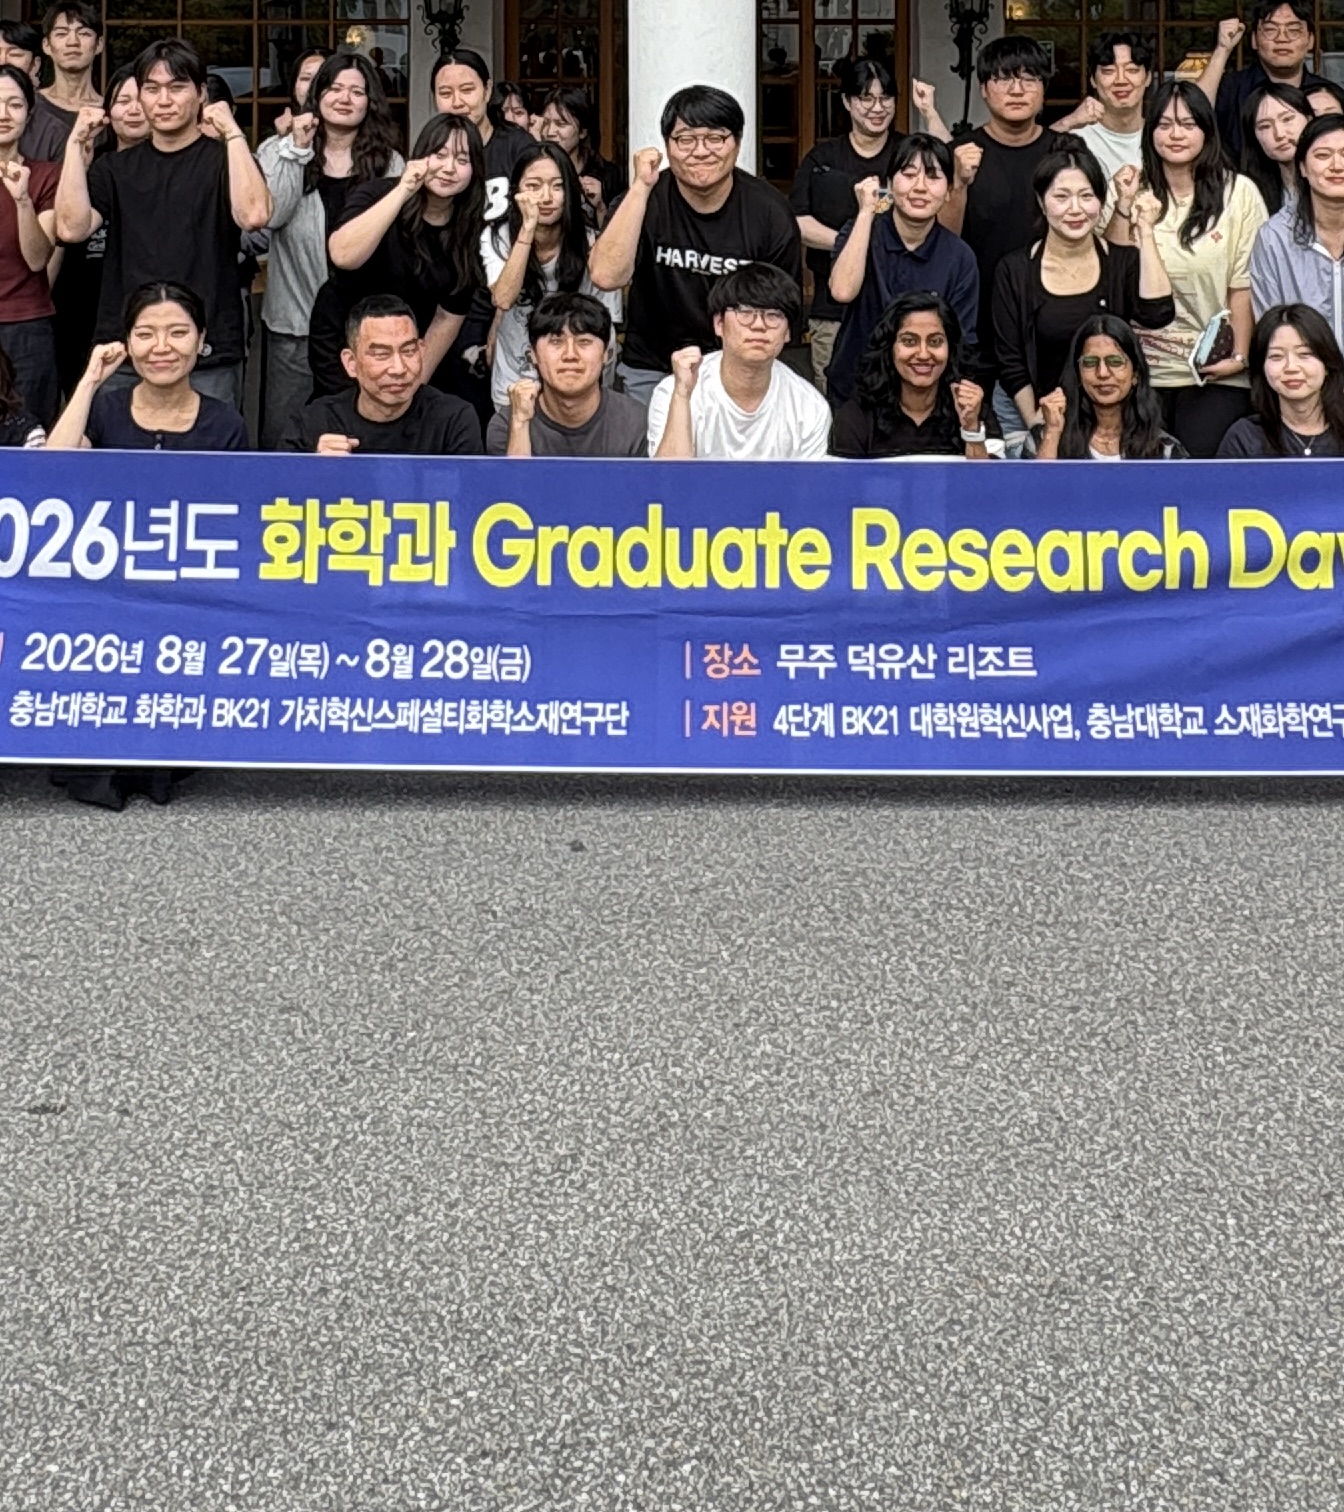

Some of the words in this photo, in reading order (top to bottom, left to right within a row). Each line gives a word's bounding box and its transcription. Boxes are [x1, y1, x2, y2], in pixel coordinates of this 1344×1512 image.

[258, 497, 456, 587] 화학과
[472, 502, 833, 590] Graduate
[852, 506, 1210, 592] Research
[20, 631, 144, 675] 2026년
[155, 634, 207, 676] 8월
[420, 638, 532, 682] 28일(금)
[702, 643, 762, 679] 장소
[776, 644, 838, 680] 무주
[848, 643, 937, 680] 덕유산
[947, 643, 1038, 681] 리조트
[9, 690, 128, 728] 충남대학교
[133, 693, 207, 730] 화학과
[211, 697, 271, 730] BK21
[278, 696, 630, 736] 가치혁신스페셜티화학소재연구단
[701, 701, 757, 738] 지원
[773, 702, 835, 738] 4단계
[841, 704, 899, 737] BK21
[909, 702, 1081, 741] 대학원혁신사업,
[1086, 702, 1208, 739] 충남대학교
